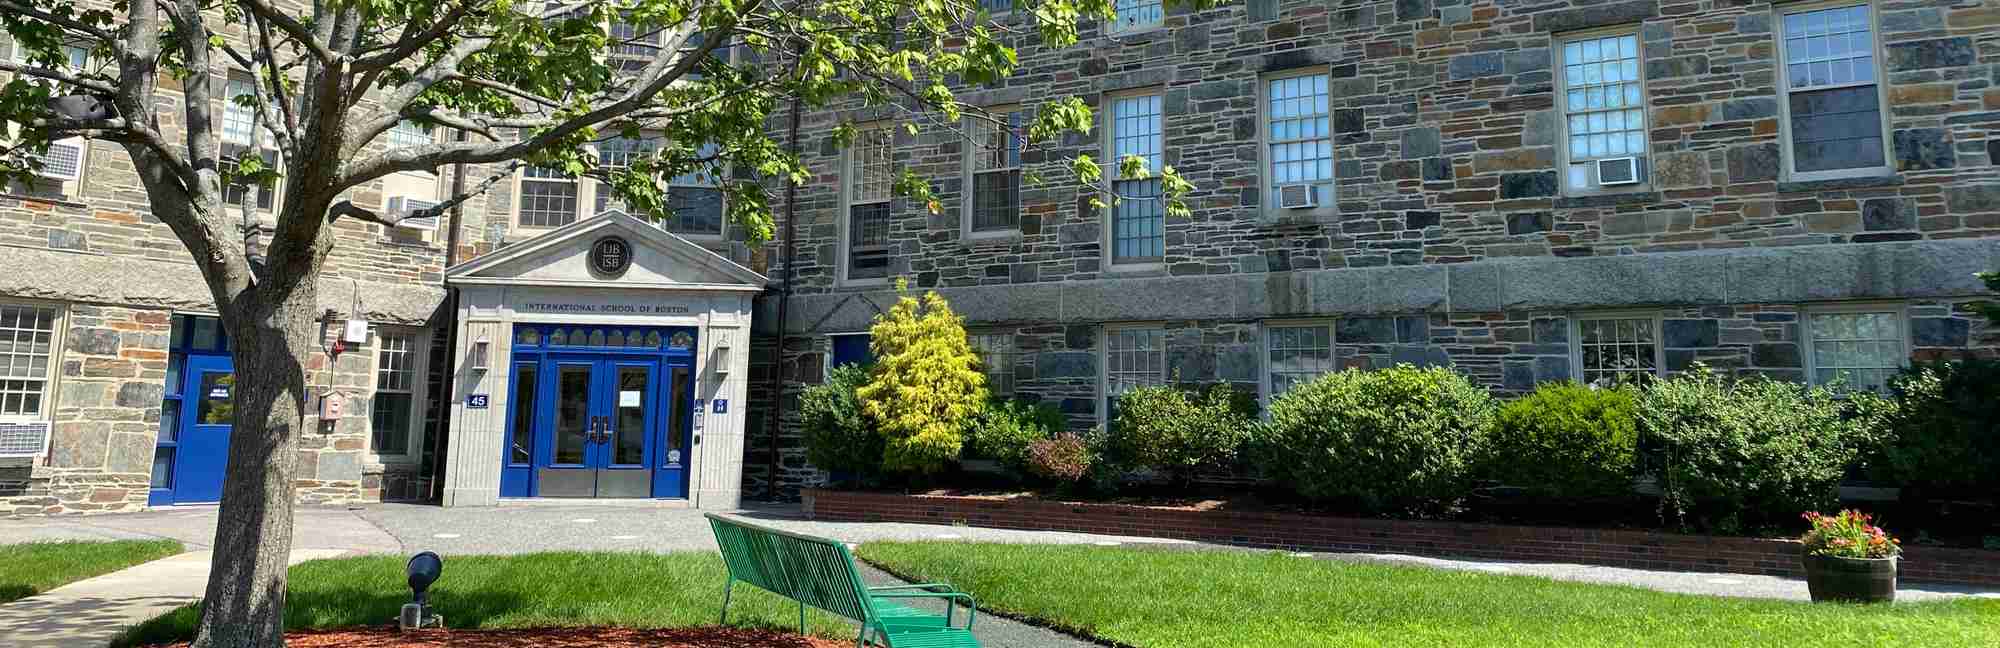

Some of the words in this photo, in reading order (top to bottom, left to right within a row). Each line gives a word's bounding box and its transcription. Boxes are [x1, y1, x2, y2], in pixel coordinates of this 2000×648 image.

[524, 303, 595, 312] INTERNATIONAL
[601, 304, 635, 313] SCHOOL
[639, 304, 650, 313] OF
[655, 304, 689, 314] BOSTON
[471, 396, 485, 406] 45
